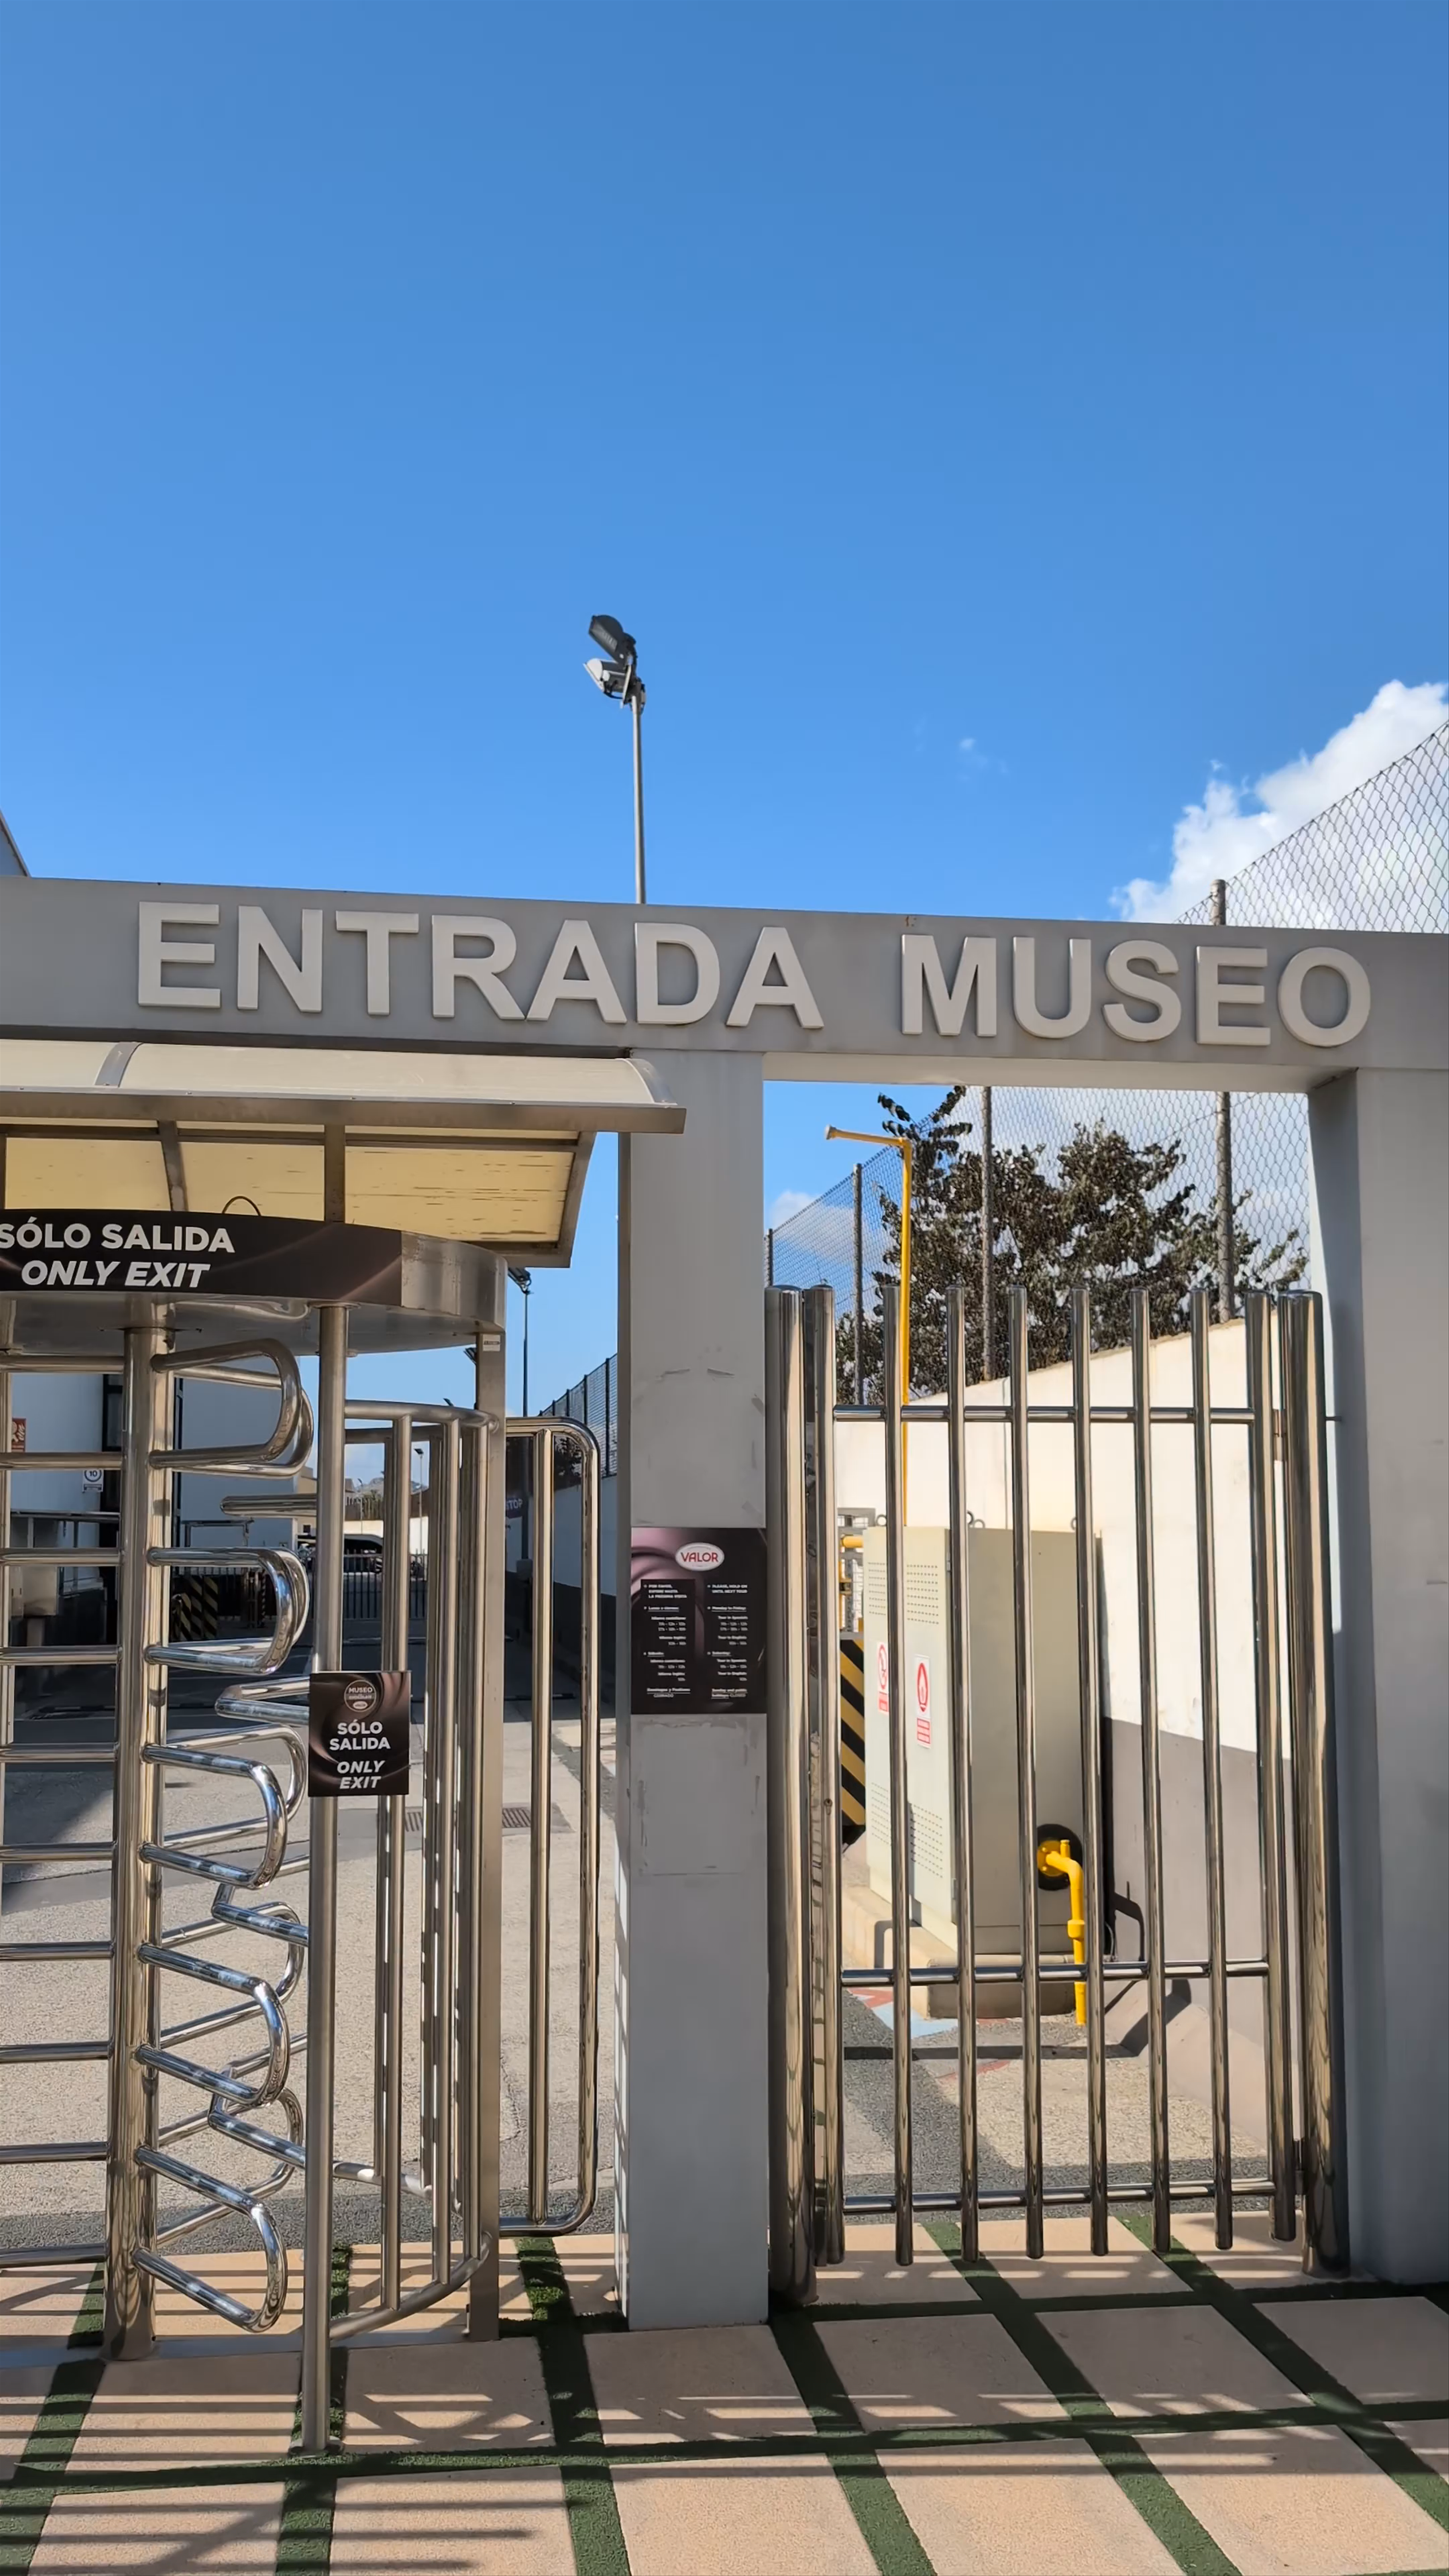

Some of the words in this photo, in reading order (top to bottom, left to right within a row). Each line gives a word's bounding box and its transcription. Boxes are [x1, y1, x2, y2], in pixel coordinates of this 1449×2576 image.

[137, 902, 824, 1029] ENTRADA
[901, 934, 1371, 1047] MUSEO
[0, 1216, 91, 1249] SÓLO
[101, 1224, 235, 1253] SALIDA
[21, 1260, 120, 1286] ONLY
[124, 1262, 211, 1288] EXIT
[680, 1552, 718, 1562] VALOR
[337, 1719, 383, 1735] SÓLO
[329, 1737, 391, 1750] SALIDA
[337, 1760, 385, 1773] ONLY
[340, 1776, 381, 1789] EXIT
